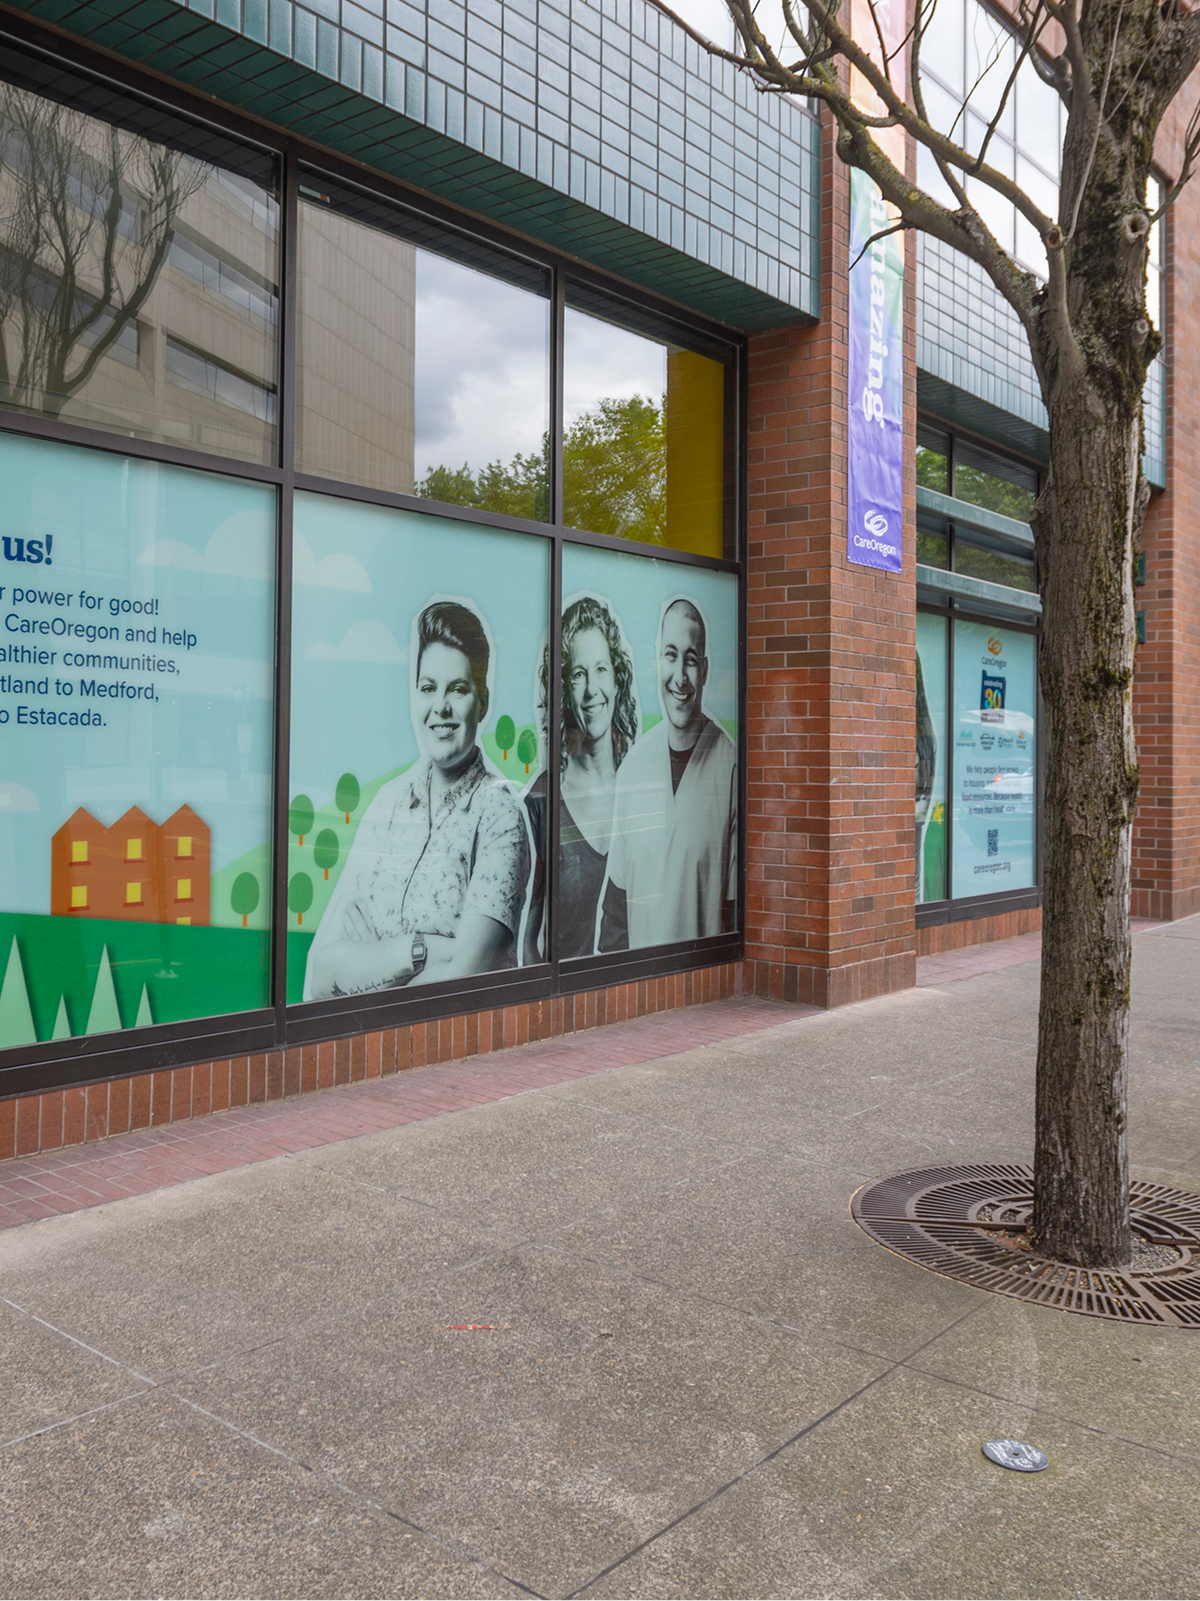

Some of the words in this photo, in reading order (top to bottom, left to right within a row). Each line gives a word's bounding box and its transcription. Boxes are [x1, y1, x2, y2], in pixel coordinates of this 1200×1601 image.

[863, 189, 888, 428] amazing
[1, 534, 53, 565] us!
[854, 534, 896, 557] CareOregon
[13, 587, 73, 607] power
[79, 591, 104, 610] for
[109, 598, 159, 616] good!
[5, 613, 119, 643] CareOregon
[125, 627, 156, 643] and
[162, 627, 197, 650] help
[63, 653, 180, 676] communities,
[981, 656, 1007, 669] CareOregon
[55, 679, 74, 696] to
[80, 679, 159, 703] Medford,
[985, 688, 1002, 710] 30
[17, 706, 107, 727] Estacada.
